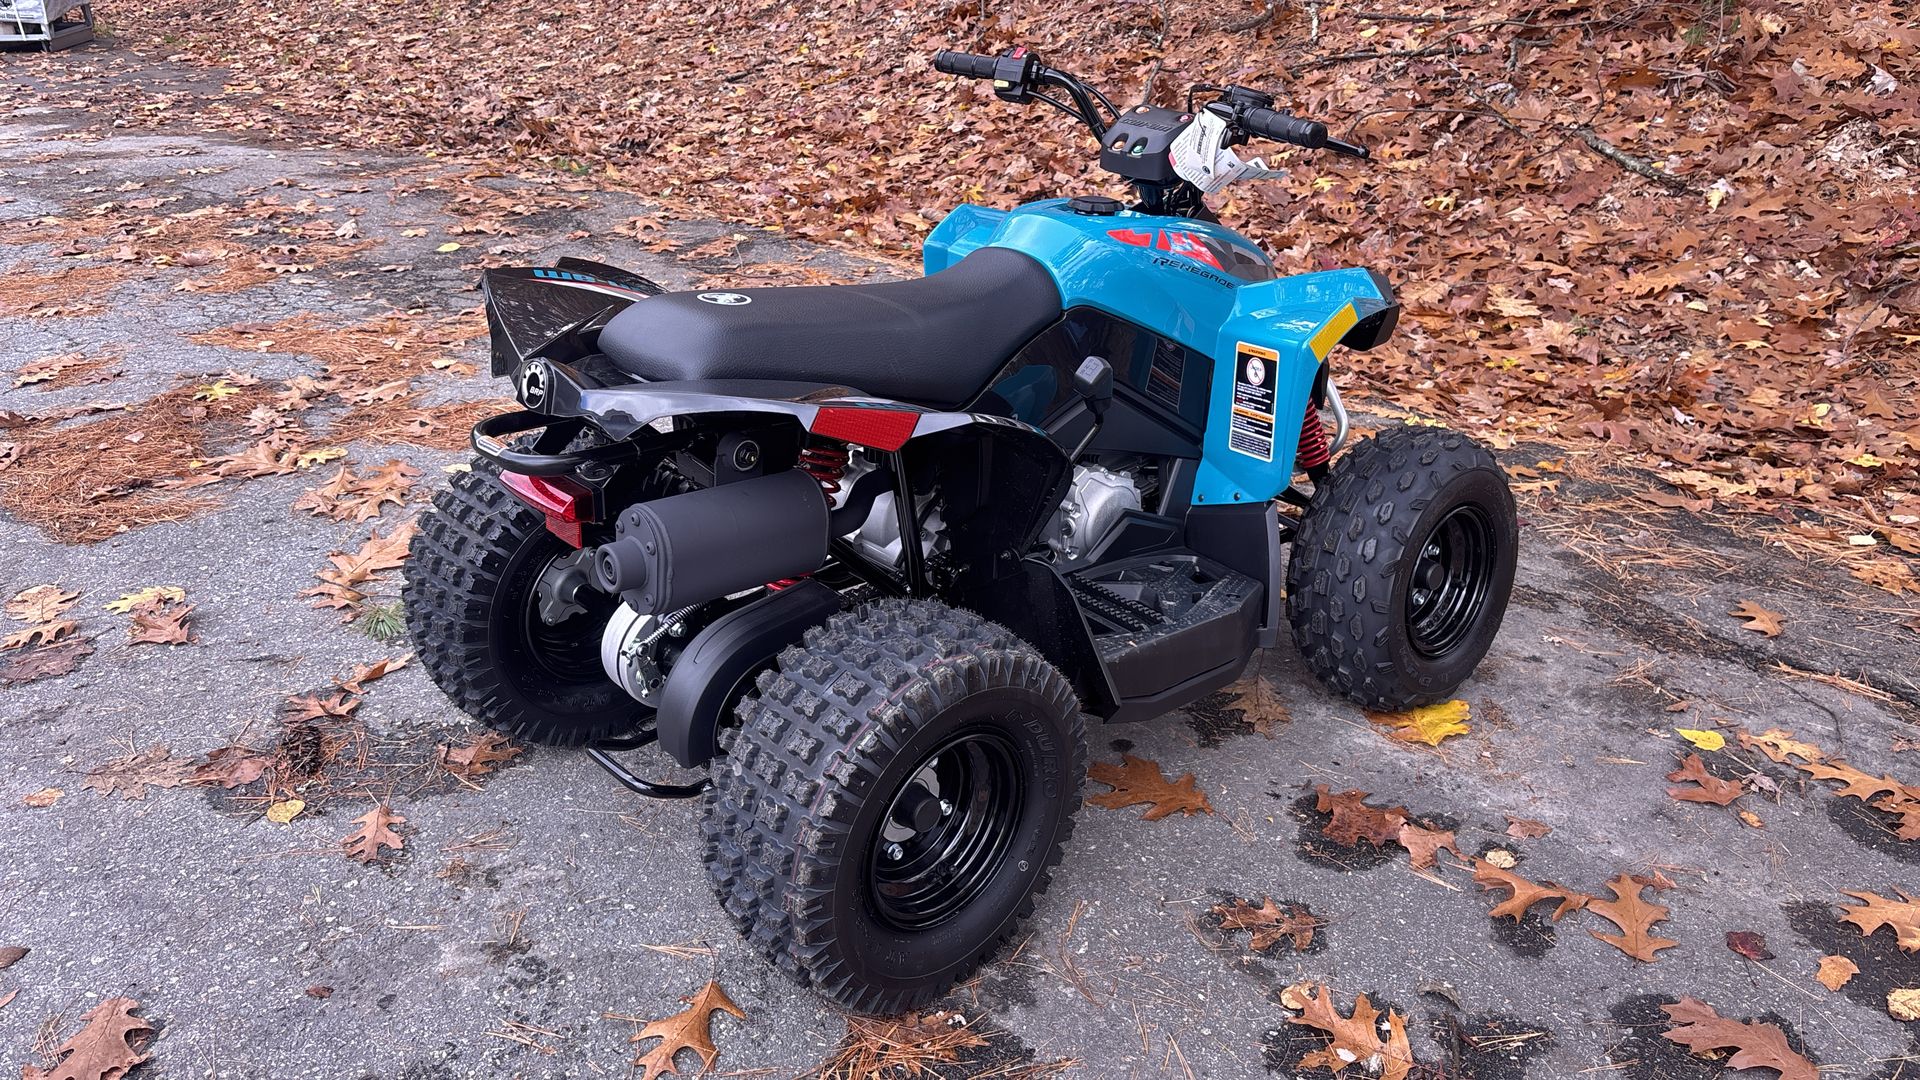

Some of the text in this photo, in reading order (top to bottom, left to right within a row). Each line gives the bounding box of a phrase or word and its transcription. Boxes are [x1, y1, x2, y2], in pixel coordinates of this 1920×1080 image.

[1152, 257, 1236, 290] RENEGADE
[529, 385, 544, 397] BRP
[1023, 718, 1059, 799] DURO
